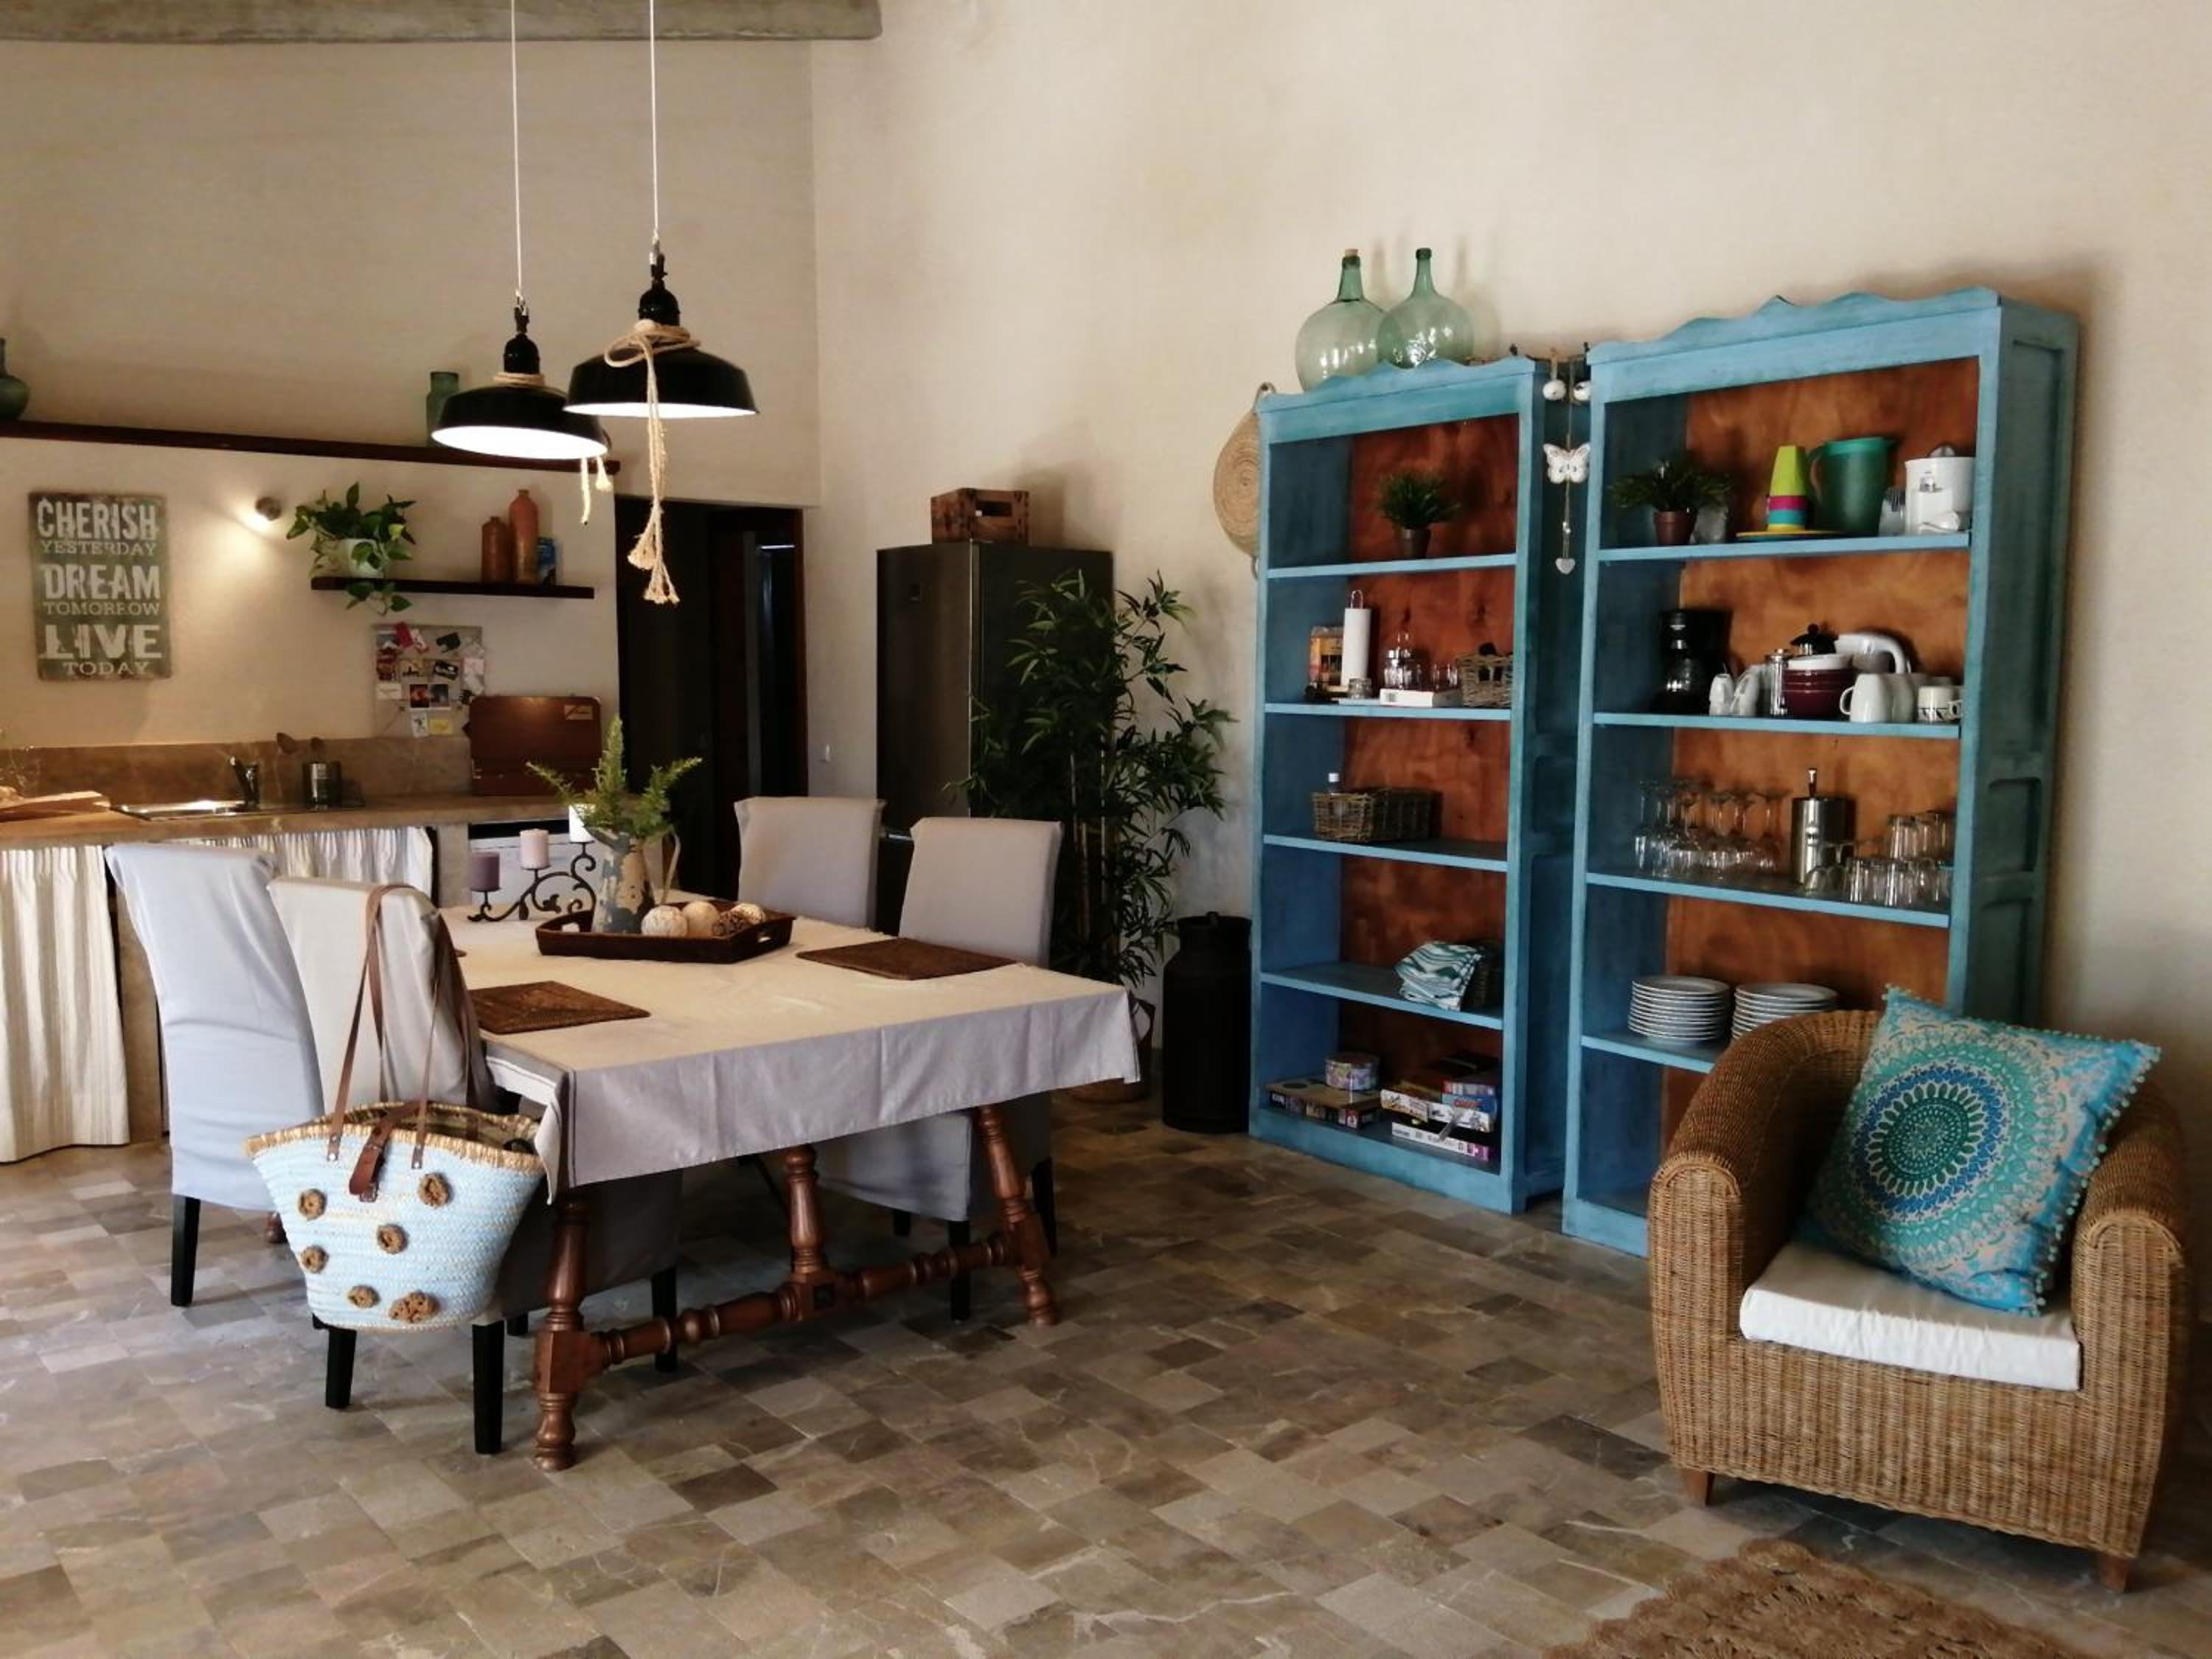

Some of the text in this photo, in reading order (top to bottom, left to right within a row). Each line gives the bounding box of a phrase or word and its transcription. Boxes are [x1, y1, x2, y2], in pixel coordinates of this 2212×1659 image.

[38, 498, 159, 540] CHERISH
[41, 540, 156, 556] YESTERDAY
[40, 563, 160, 599] DREAM
[44, 602, 159, 615] TOMORROW
[40, 625, 162, 658] LIVE
[63, 661, 150, 675] TODAY
